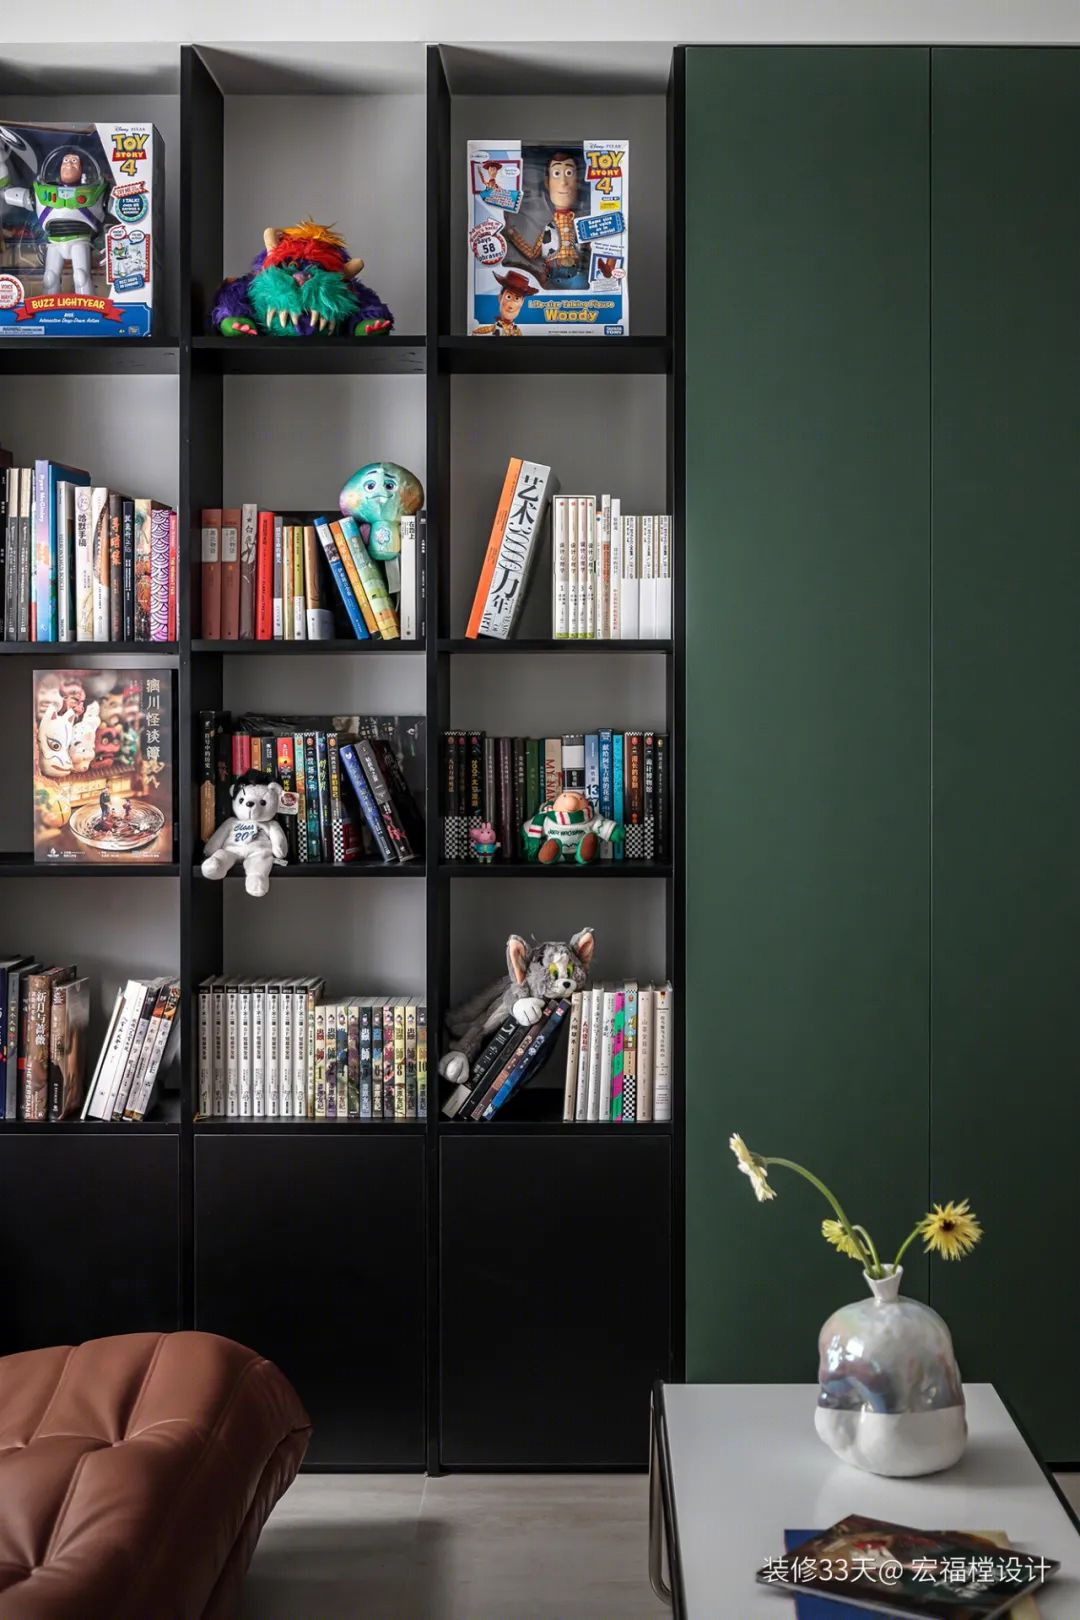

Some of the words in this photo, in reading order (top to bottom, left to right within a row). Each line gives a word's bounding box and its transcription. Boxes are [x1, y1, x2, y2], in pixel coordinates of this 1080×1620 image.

[111, 133, 150, 151] TOY
[586, 150, 625, 168] TOY
[120, 159, 137, 176] 4
[595, 176, 613, 194] 4
[477, 237, 492, 245] Says
[482, 243, 496, 254] 58
[478, 250, 504, 262] phrases!
[32, 298, 54, 309] BUZZ
[58, 297, 105, 310] LIGHTYEAR
[545, 310, 598, 322] Woody
[546, 759, 555, 776] MY
[586, 784, 599, 796] 13
[36, 990, 47, 1046] 新月与蔷薇
